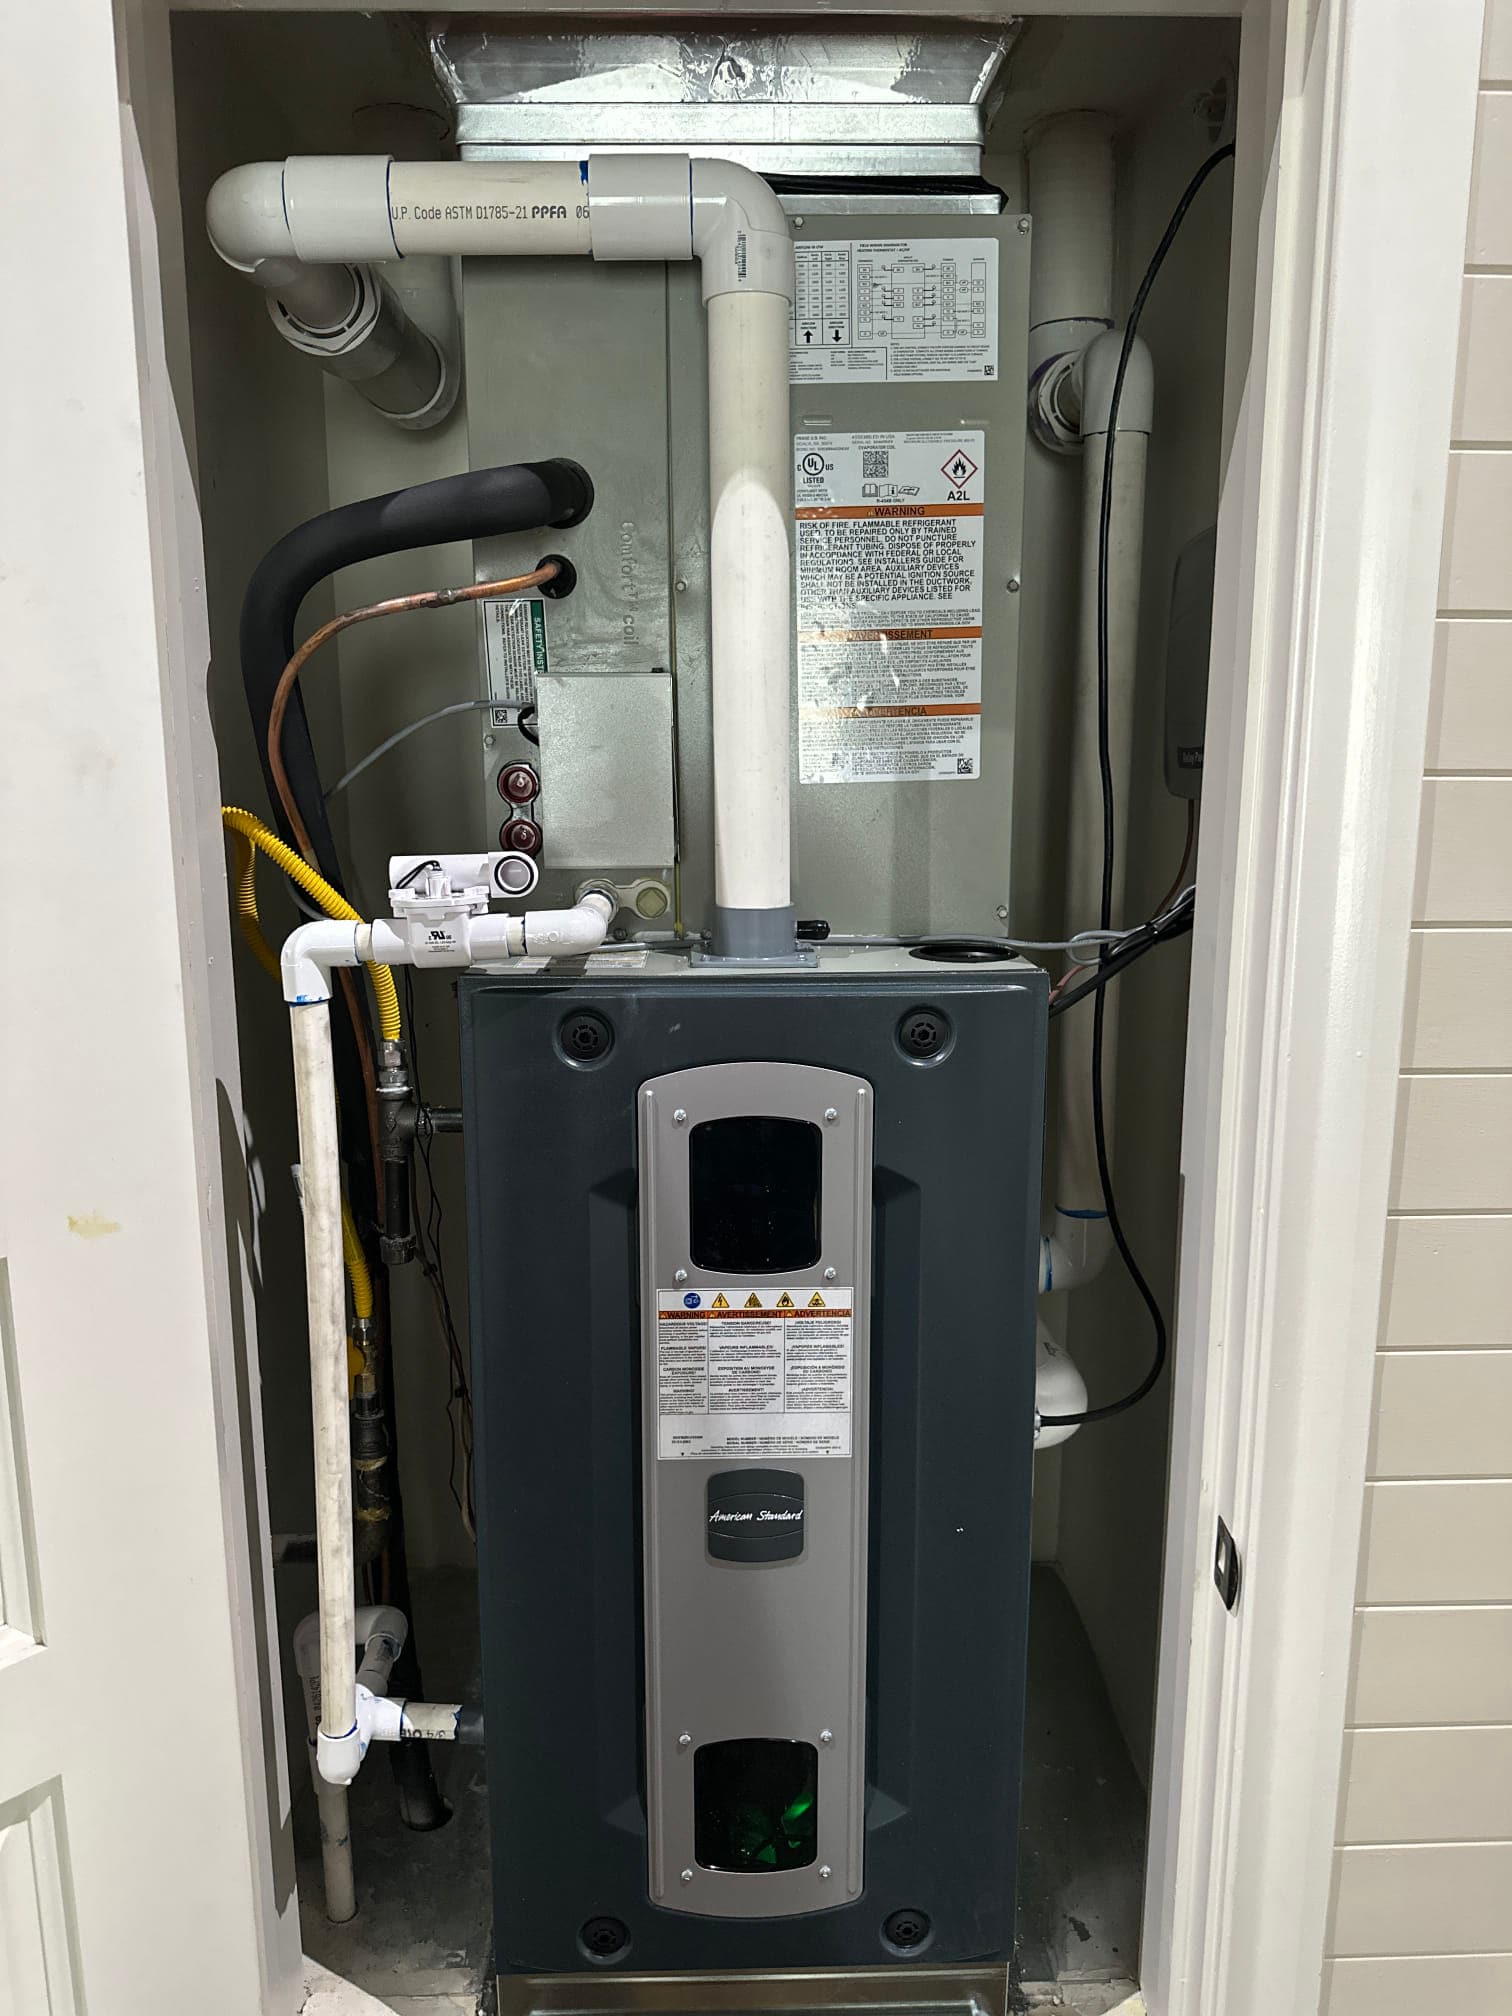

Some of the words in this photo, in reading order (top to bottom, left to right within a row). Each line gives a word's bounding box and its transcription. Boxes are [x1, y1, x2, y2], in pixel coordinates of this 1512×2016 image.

[414, 206, 441, 220] Code
[445, 206, 472, 220] ASTM
[476, 206, 528, 219] D1785-21
[532, 206, 567, 219] PPFA
[803, 476, 824, 484] LISTED
[947, 490, 970, 501] A2L
[874, 507, 925, 516] WARNING
[853, 520, 900, 528] FLAMMABLE
[903, 519, 956, 527] REFRIGERANT
[857, 579, 898, 587] INSTALLED
[926, 585, 953, 593] LISTED
[534, 617, 543, 649] SAFETY
[795, 1309, 851, 1317] ADVERTENCIA
[709, 1510, 753, 1522] American
[757, 1510, 803, 1521] Standard
